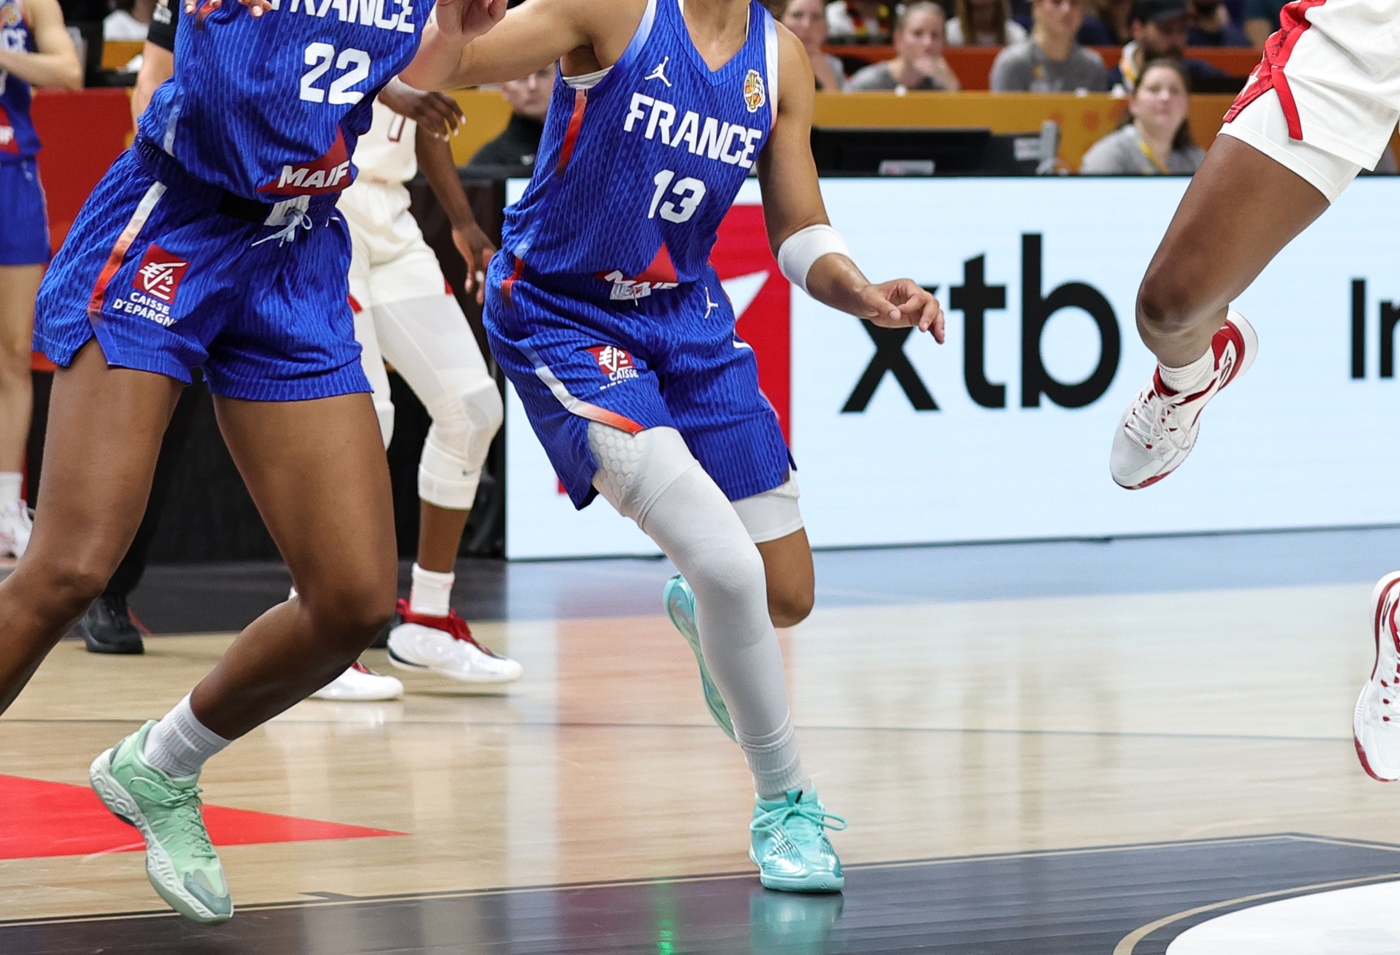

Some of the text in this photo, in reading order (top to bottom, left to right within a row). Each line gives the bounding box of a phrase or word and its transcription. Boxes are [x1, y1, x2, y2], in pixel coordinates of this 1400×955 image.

[300, 42, 371, 105] 22
[623, 92, 762, 169] FRANCE
[277, 160, 350, 188] MAIF
[648, 169, 706, 224] 13
[113, 298, 177, 327] D'EPARGN
[130, 292, 170, 315] CAISSE
[840, 232, 1122, 412] xtb
[609, 368, 639, 381] CAISSE
